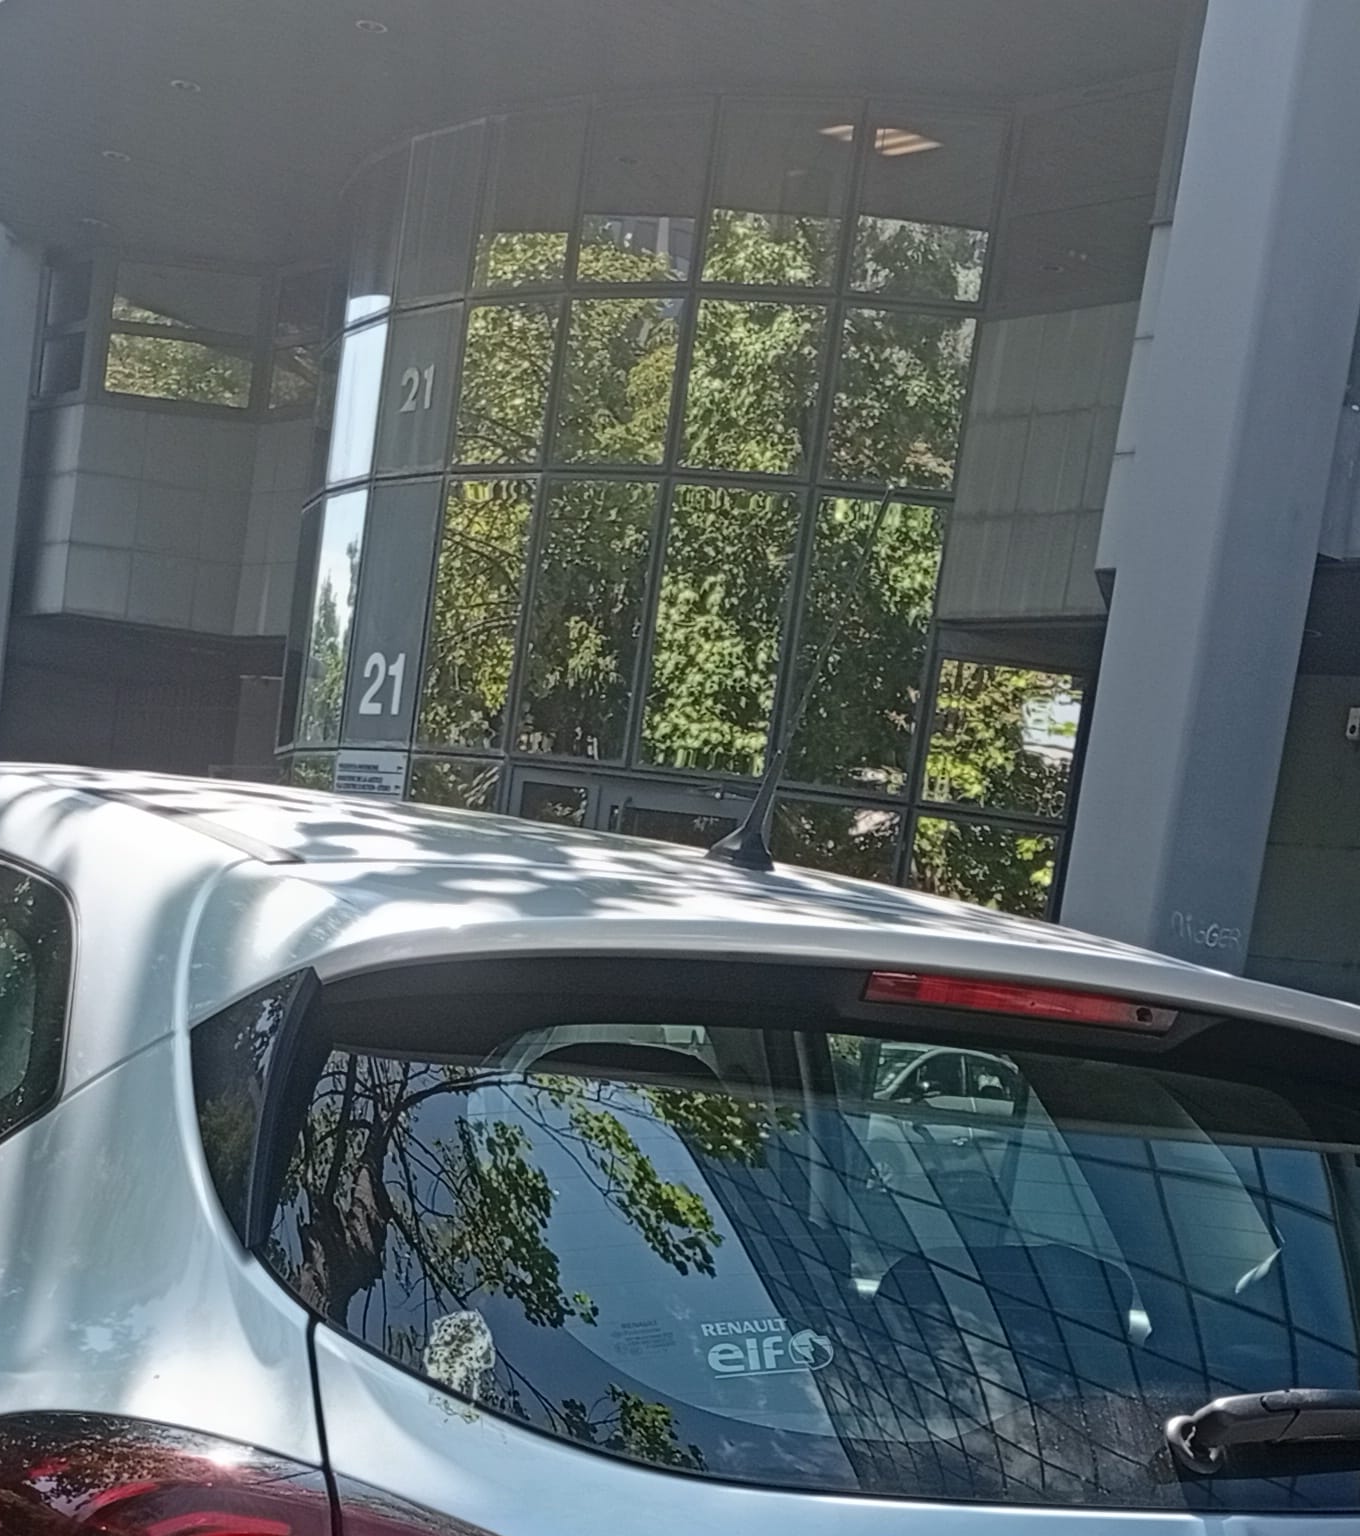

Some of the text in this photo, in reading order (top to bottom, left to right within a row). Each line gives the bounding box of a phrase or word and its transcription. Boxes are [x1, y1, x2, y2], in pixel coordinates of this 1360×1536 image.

[399, 363, 436, 414] 21
[358, 651, 407, 716] 21
[700, 1318, 787, 1337] RENAULT
[707, 1335, 785, 1373] elf
